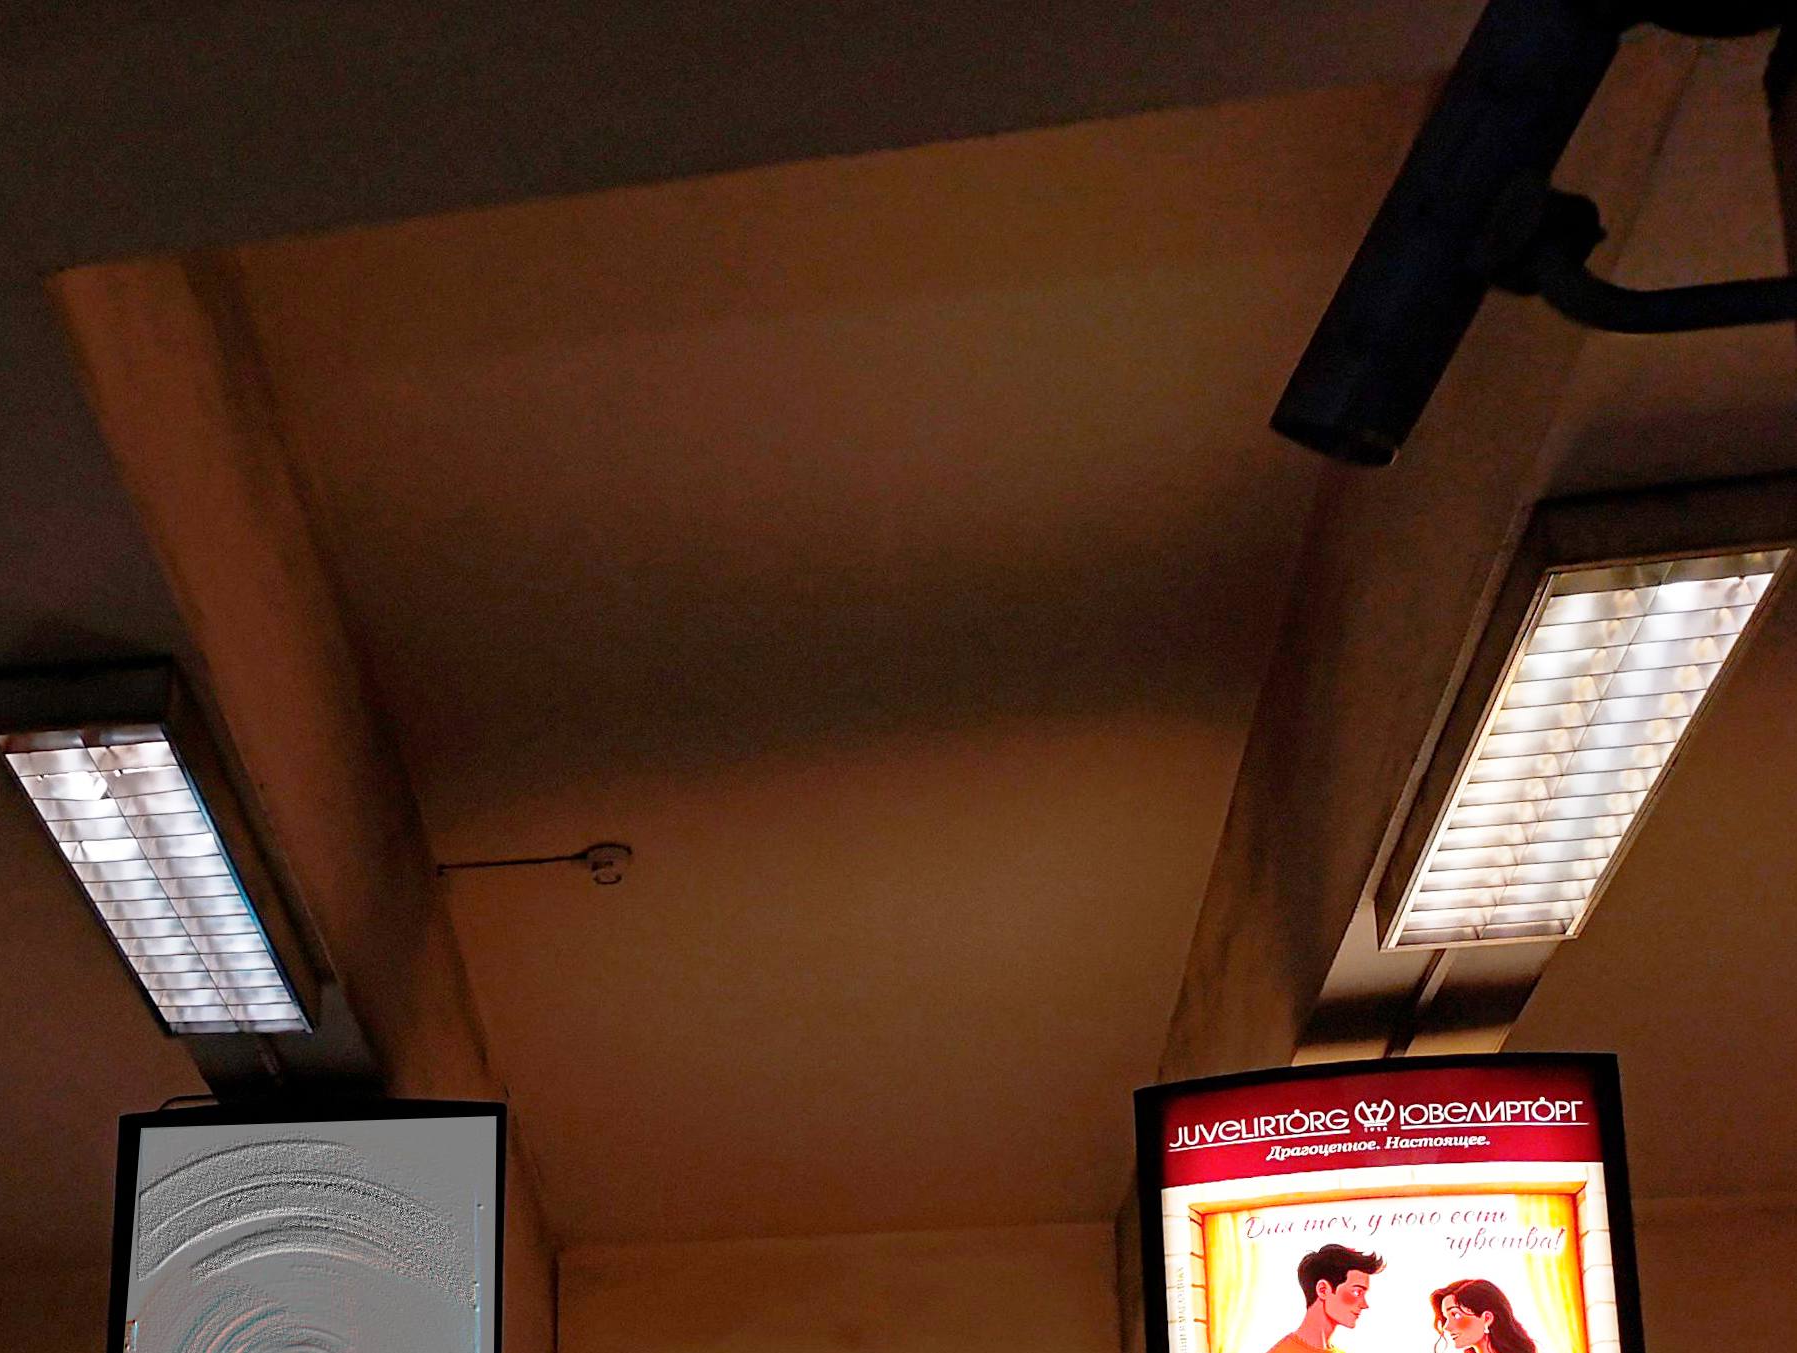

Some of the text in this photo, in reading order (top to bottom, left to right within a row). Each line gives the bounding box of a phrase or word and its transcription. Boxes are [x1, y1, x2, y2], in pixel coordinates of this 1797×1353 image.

[1265, 1136, 1491, 1161] Драгоценное. Настоящее.
[1245, 1209, 1507, 1239] Для тех, у кого есть
[1446, 1226, 1566, 1259] чувства!
